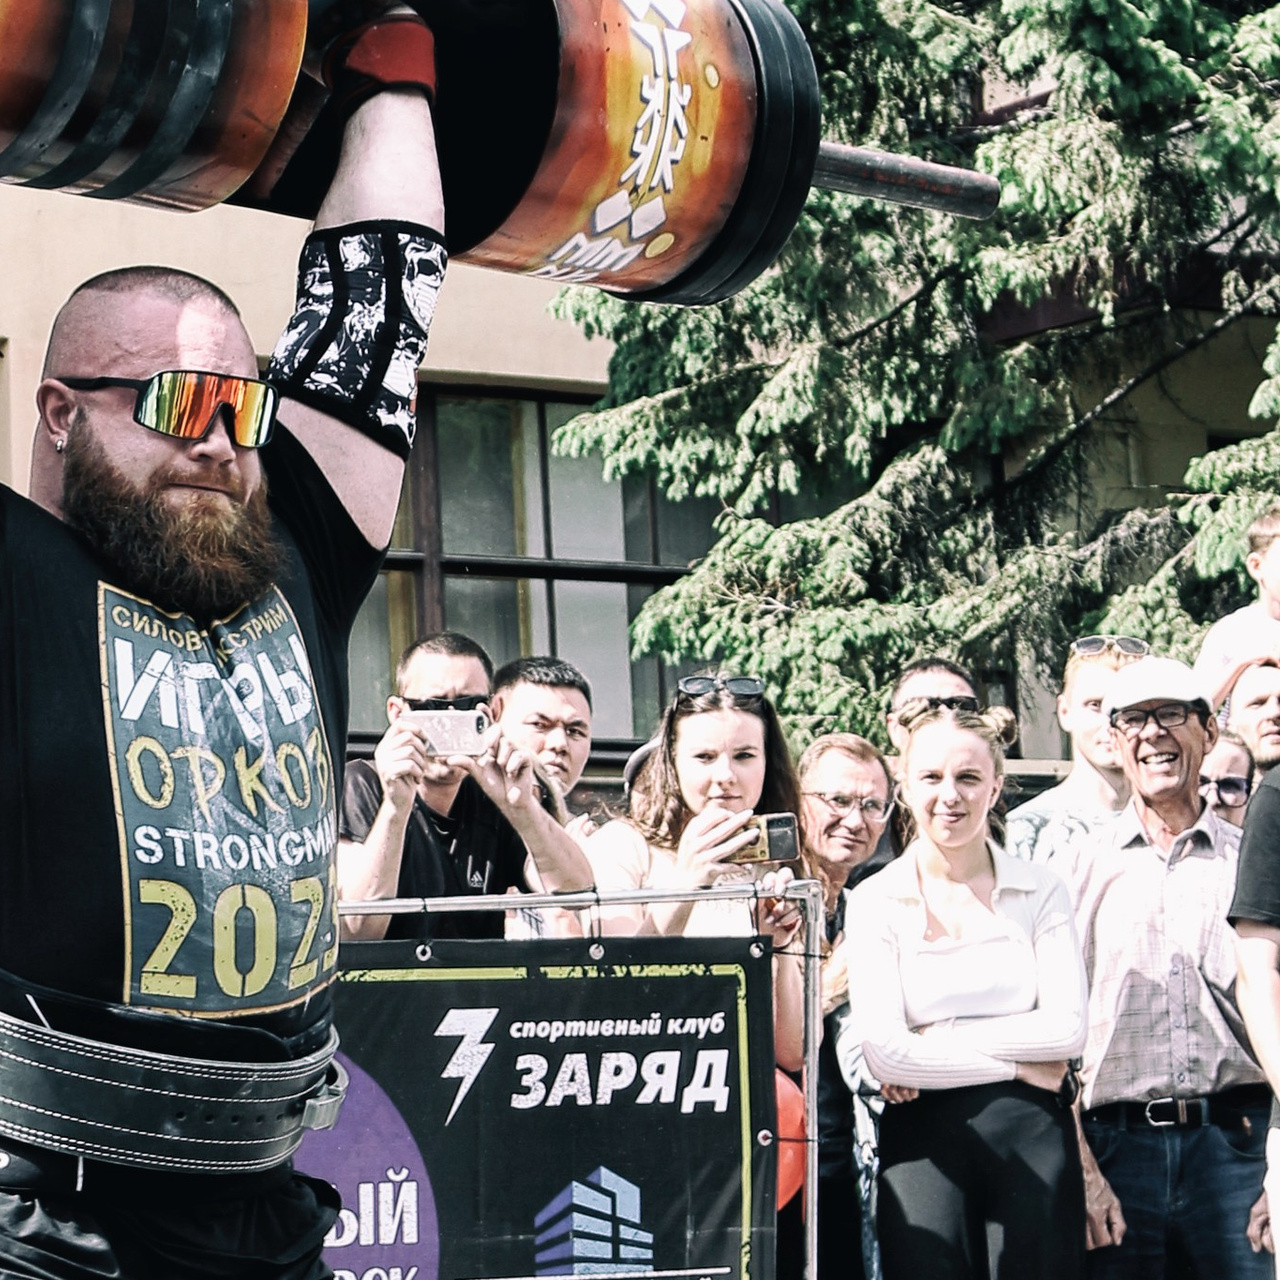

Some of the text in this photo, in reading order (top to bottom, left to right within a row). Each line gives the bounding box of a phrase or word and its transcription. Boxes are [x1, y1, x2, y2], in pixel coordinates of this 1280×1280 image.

[111, 602, 290, 669] СИЛОВ КСТРИМ
[509, 1011, 726, 1043] спортивный клуб
[509, 1048, 731, 1114] ЗАРЯД
